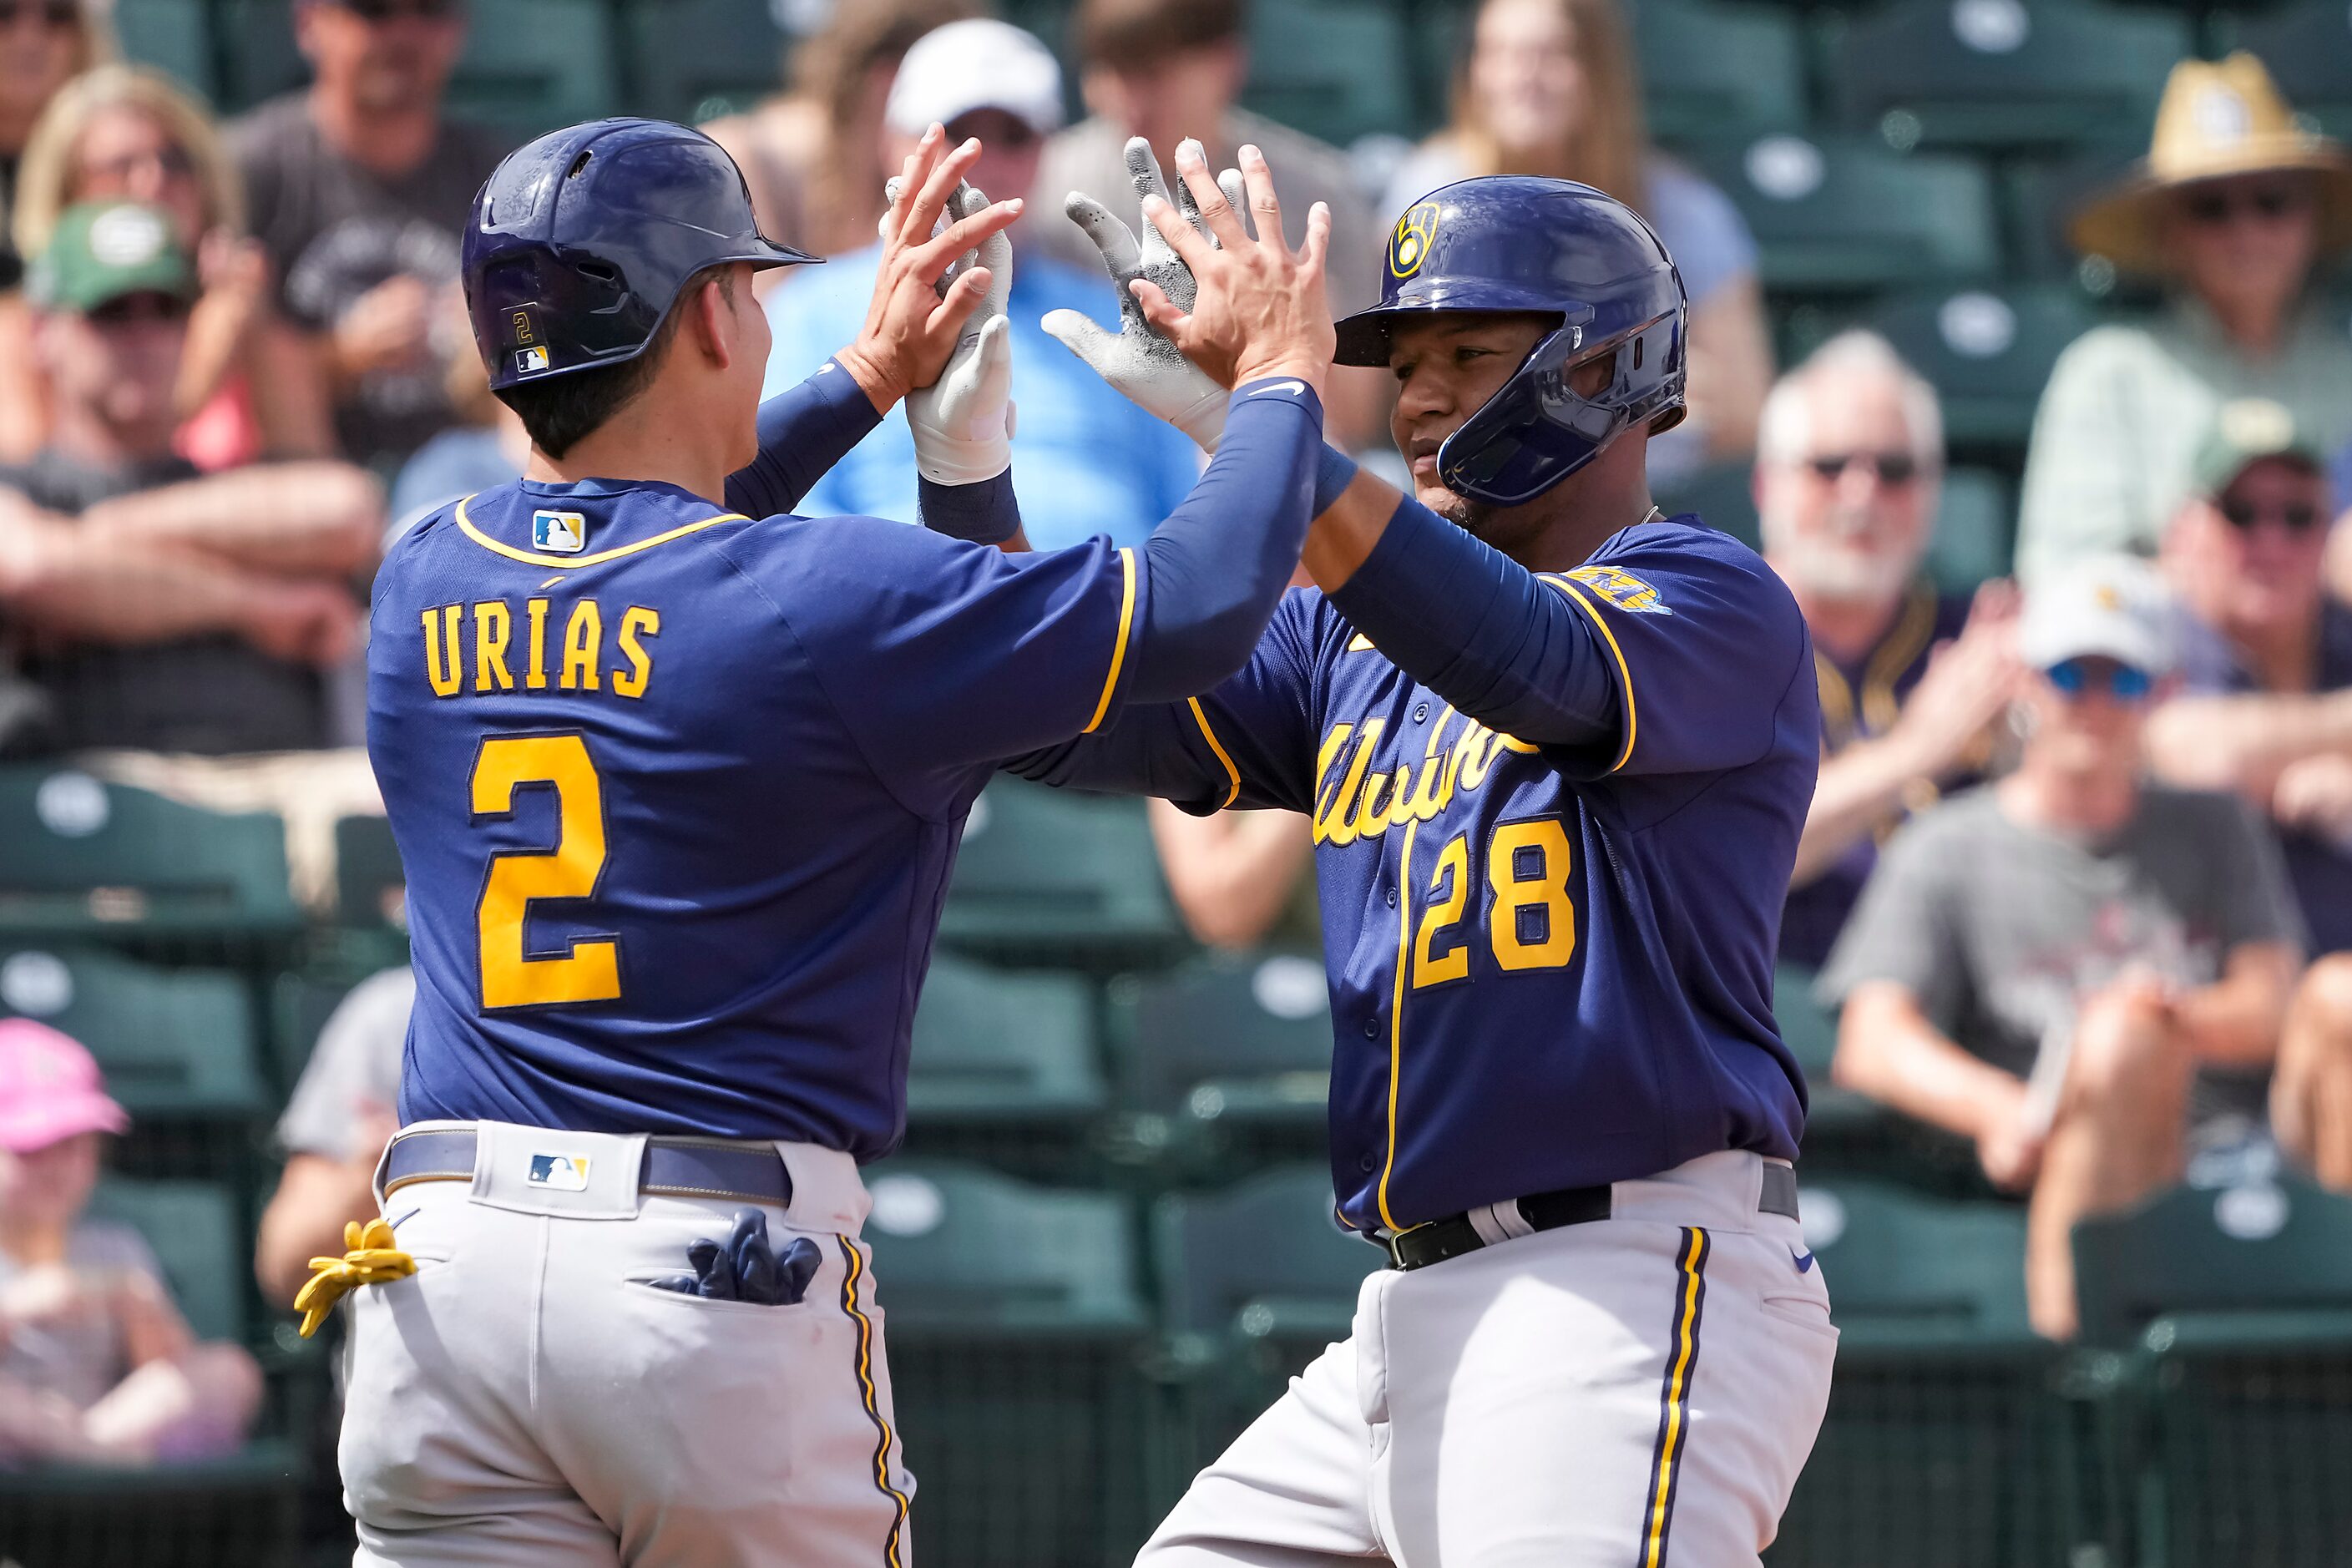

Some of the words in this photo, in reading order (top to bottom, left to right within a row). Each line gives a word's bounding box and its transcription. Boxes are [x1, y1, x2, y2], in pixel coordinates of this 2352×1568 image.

[513, 311, 534, 345] 2
[421, 576, 660, 699] URÍAS
[470, 731, 622, 1010] 2
[1413, 818, 1576, 990] 28
